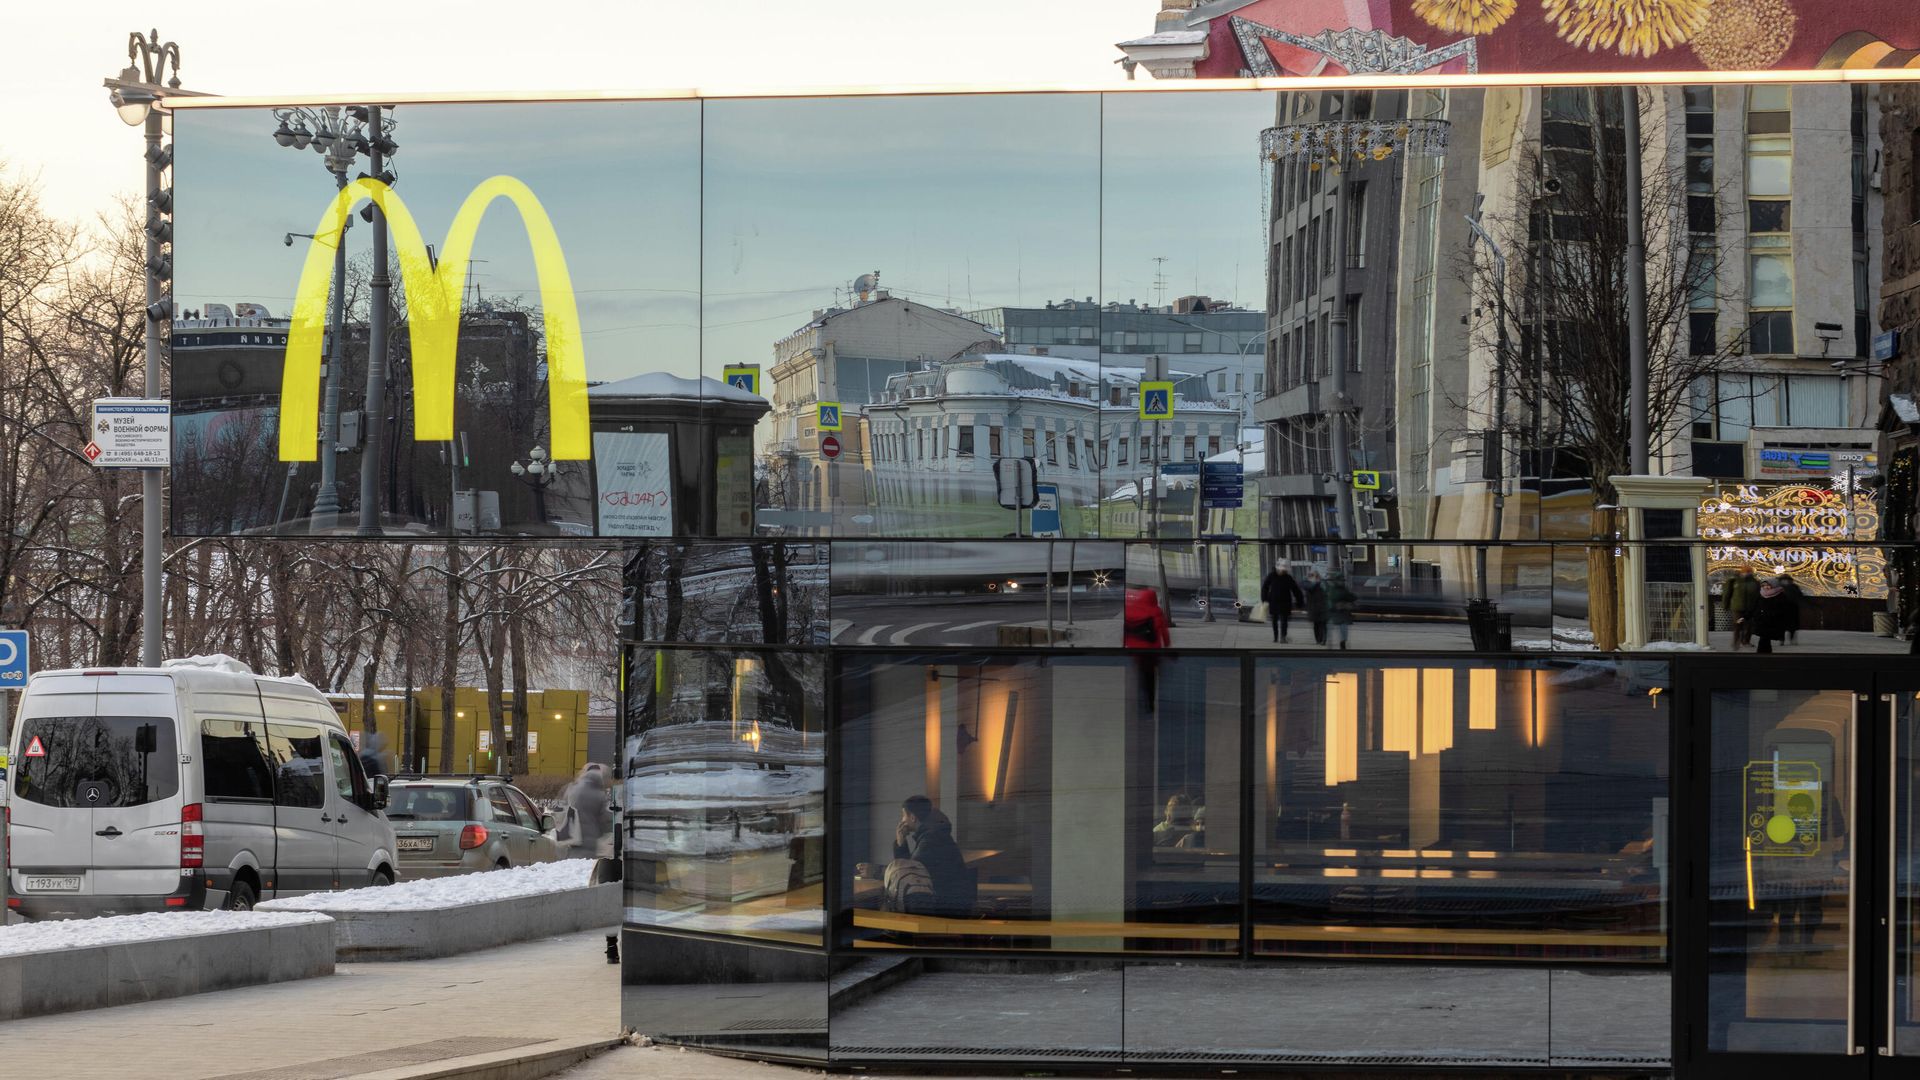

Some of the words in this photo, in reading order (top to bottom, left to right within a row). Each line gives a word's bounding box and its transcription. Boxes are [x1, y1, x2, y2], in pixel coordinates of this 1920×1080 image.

[113, 416, 135, 424] МУЗЕЙ
[113, 424, 143, 433] ВОЕННОЙ
[397, 839, 418, 848] 36ХА
[29, 878, 62, 889] Т193УК
[64, 878, 77, 886] 197
